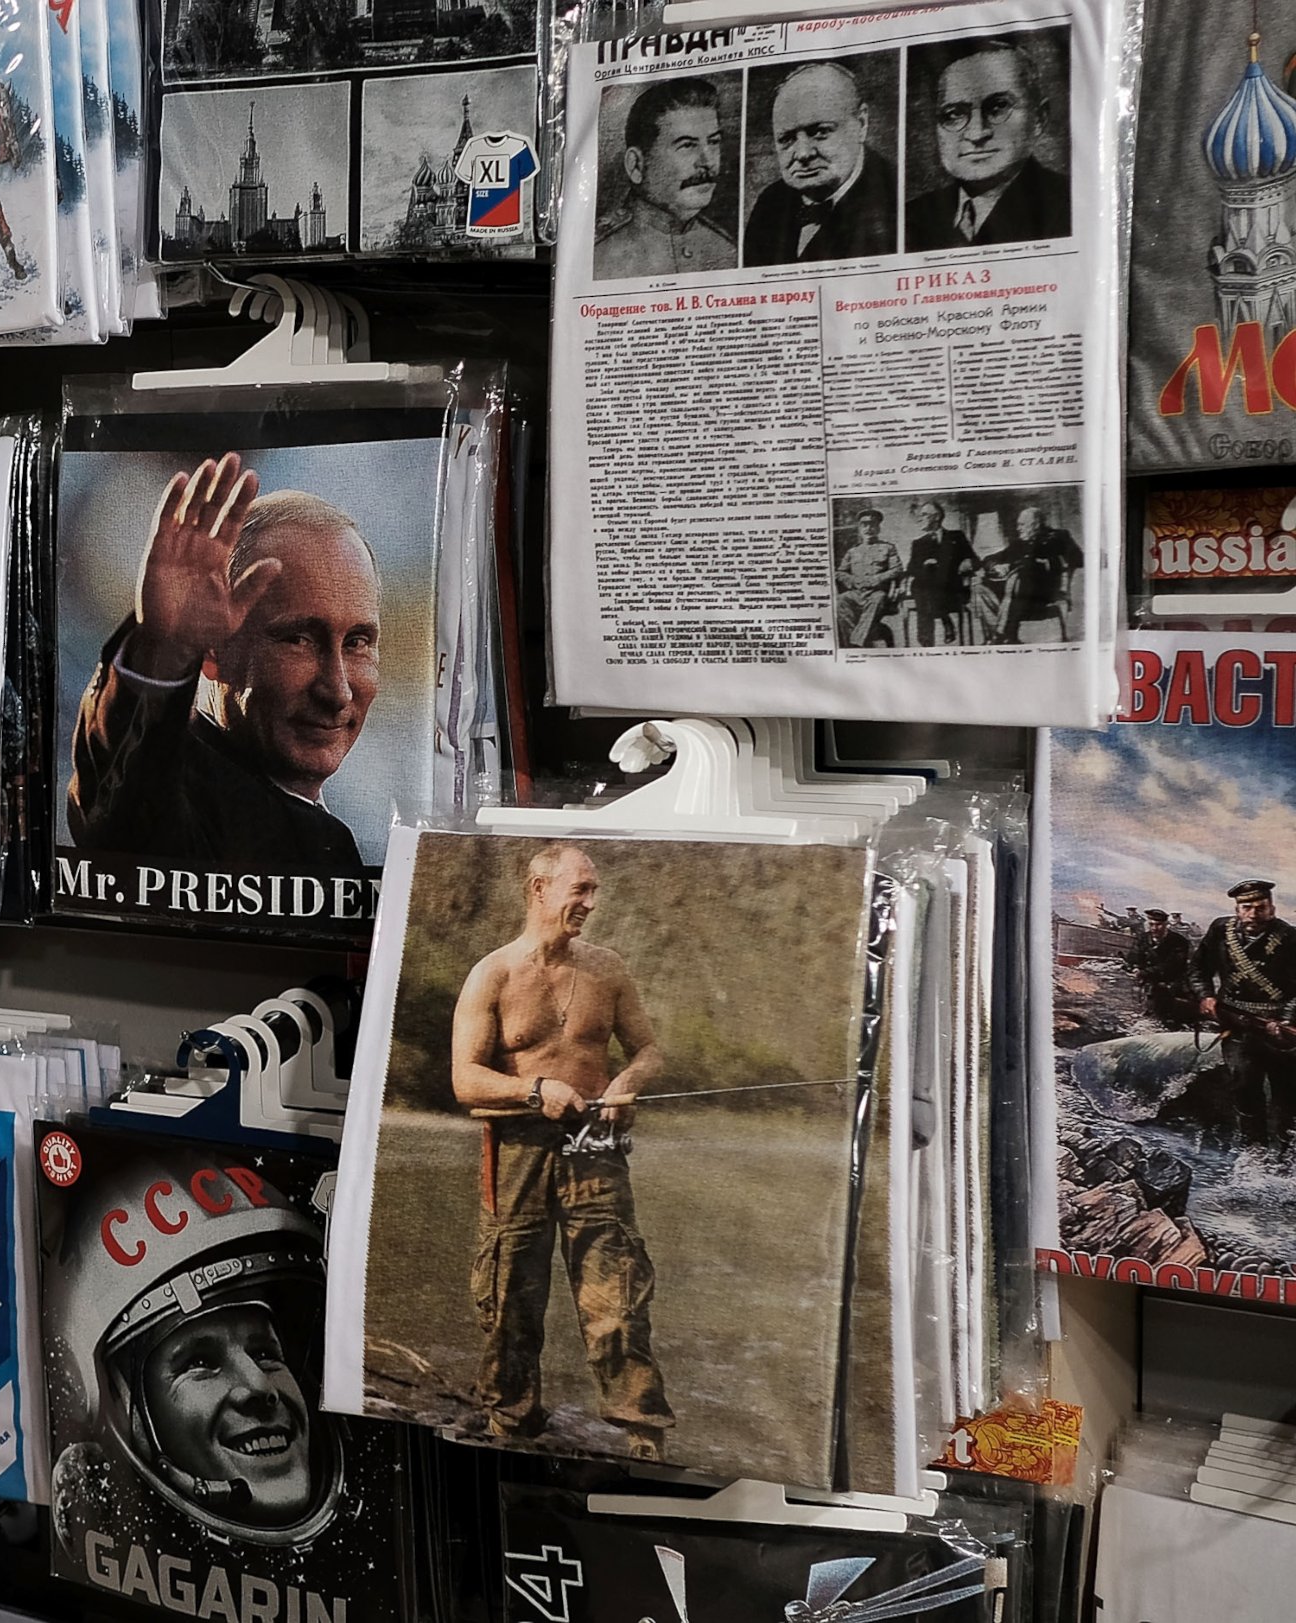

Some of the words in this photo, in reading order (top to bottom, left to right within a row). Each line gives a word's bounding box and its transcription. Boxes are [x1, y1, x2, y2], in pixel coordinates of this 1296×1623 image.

[594, 68, 621, 80] Орган
[624, 57, 694, 74] Центрального
[697, 51, 744, 65] Комитета
[747, 45, 776, 56] КПСС
[479, 160, 505, 183] XL
[475, 190, 489, 198] SIZE
[896, 269, 991, 291] ПРИКАЗ
[580, 303, 647, 319] Обращение
[650, 303, 673, 313] тов.
[676, 296, 689, 311] И.
[692, 295, 703, 309] В.
[706, 293, 757, 308] Сталина
[760, 294, 768, 304] к
[771, 290, 816, 305] народу
[835, 297, 908, 313] Верховного
[853, 322, 870, 331] по
[877, 314, 929, 328] войскам
[937, 307, 994, 323] Красной
[1001, 303, 1048, 317] Армии
[875, 324, 992, 344] Военно-Морскому
[1000, 319, 1042, 331] Флоту
[55, 856, 125, 903] Mr.
[43, 1136, 76, 1154] QUALITY
[44, 1160, 77, 1182] T-SHIRT
[100, 1167, 271, 1267] СССР
[84, 1529, 350, 1623] GAGARIN
